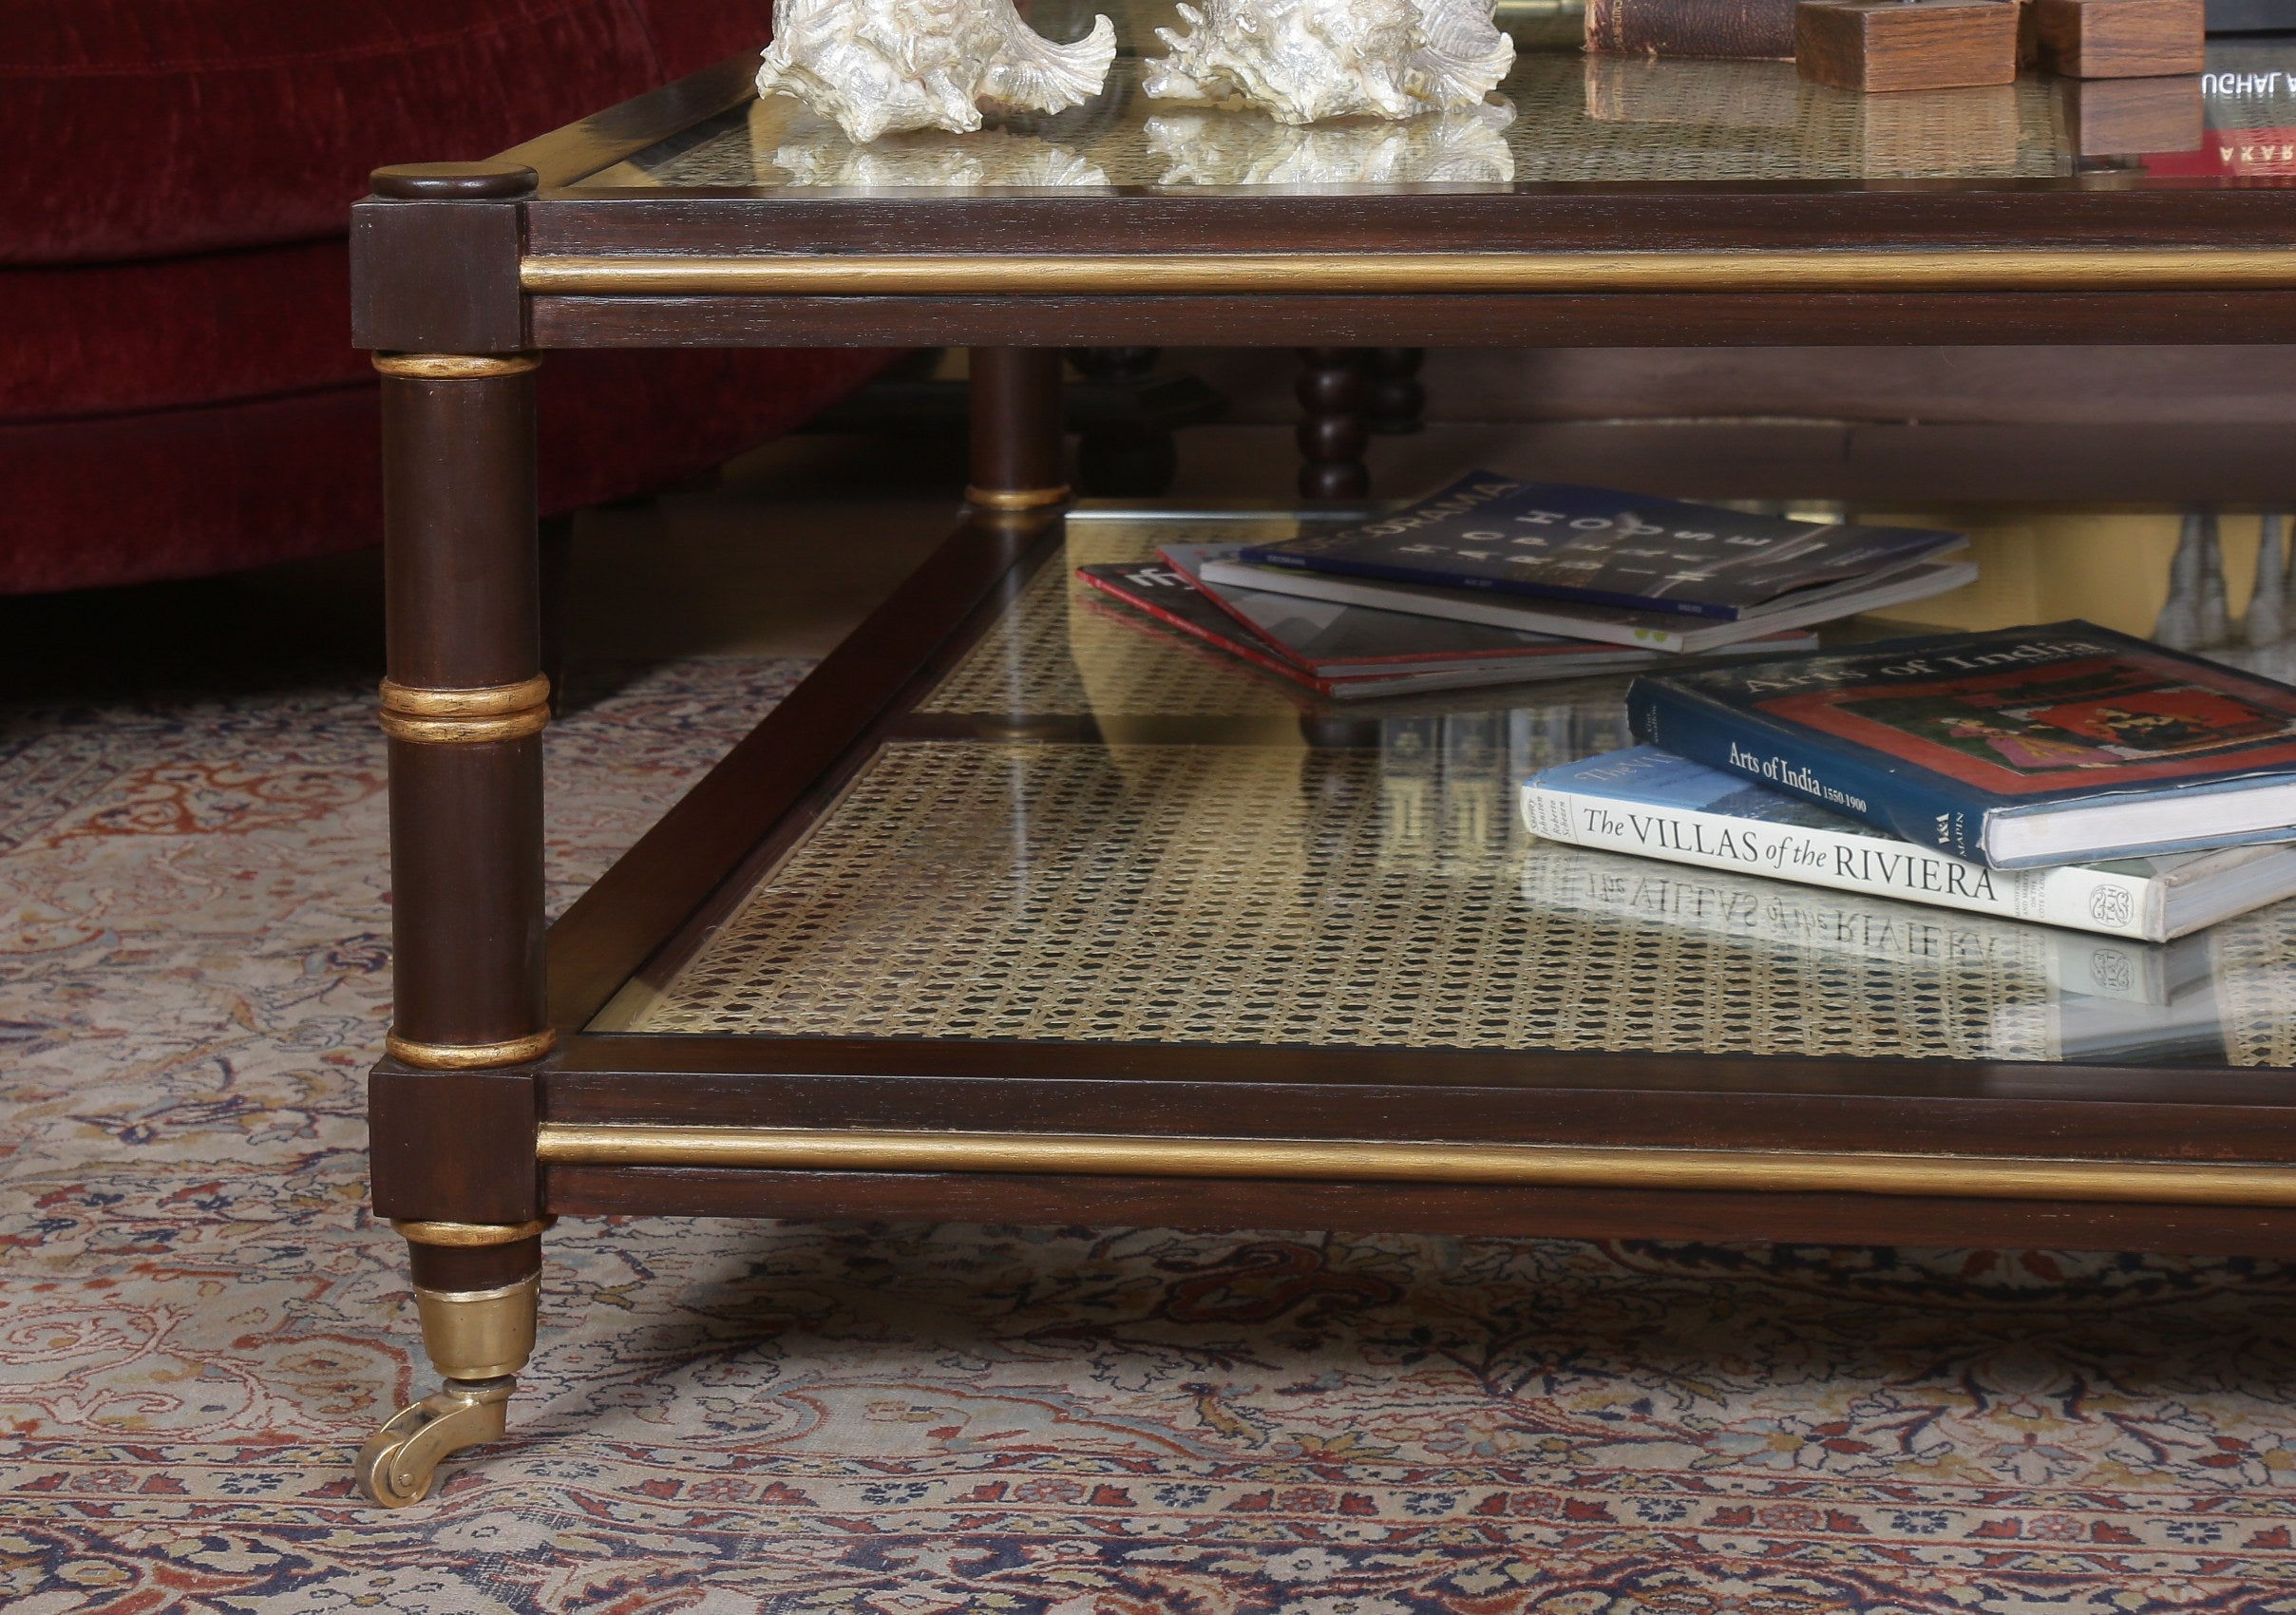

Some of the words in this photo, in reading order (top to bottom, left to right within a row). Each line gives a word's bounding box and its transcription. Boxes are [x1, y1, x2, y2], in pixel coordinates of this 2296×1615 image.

[1745, 668, 1869, 694] Arts
[1880, 658, 1941, 677] of
[1938, 640, 2104, 671] India
[1729, 742, 1760, 774] Arts
[1763, 756, 1781, 779] of
[1781, 761, 1822, 797] India
[1823, 787, 1867, 813] 1550-1900
[1584, 807, 1625, 838] The
[1627, 813, 1759, 863] VILLAS
[1765, 838, 1793, 870] of
[1793, 844, 1828, 868] the
[1833, 844, 1999, 902] RIVIERA
[1936, 812, 1950, 846] V&A
[1955, 811, 1966, 857] MAPIN
